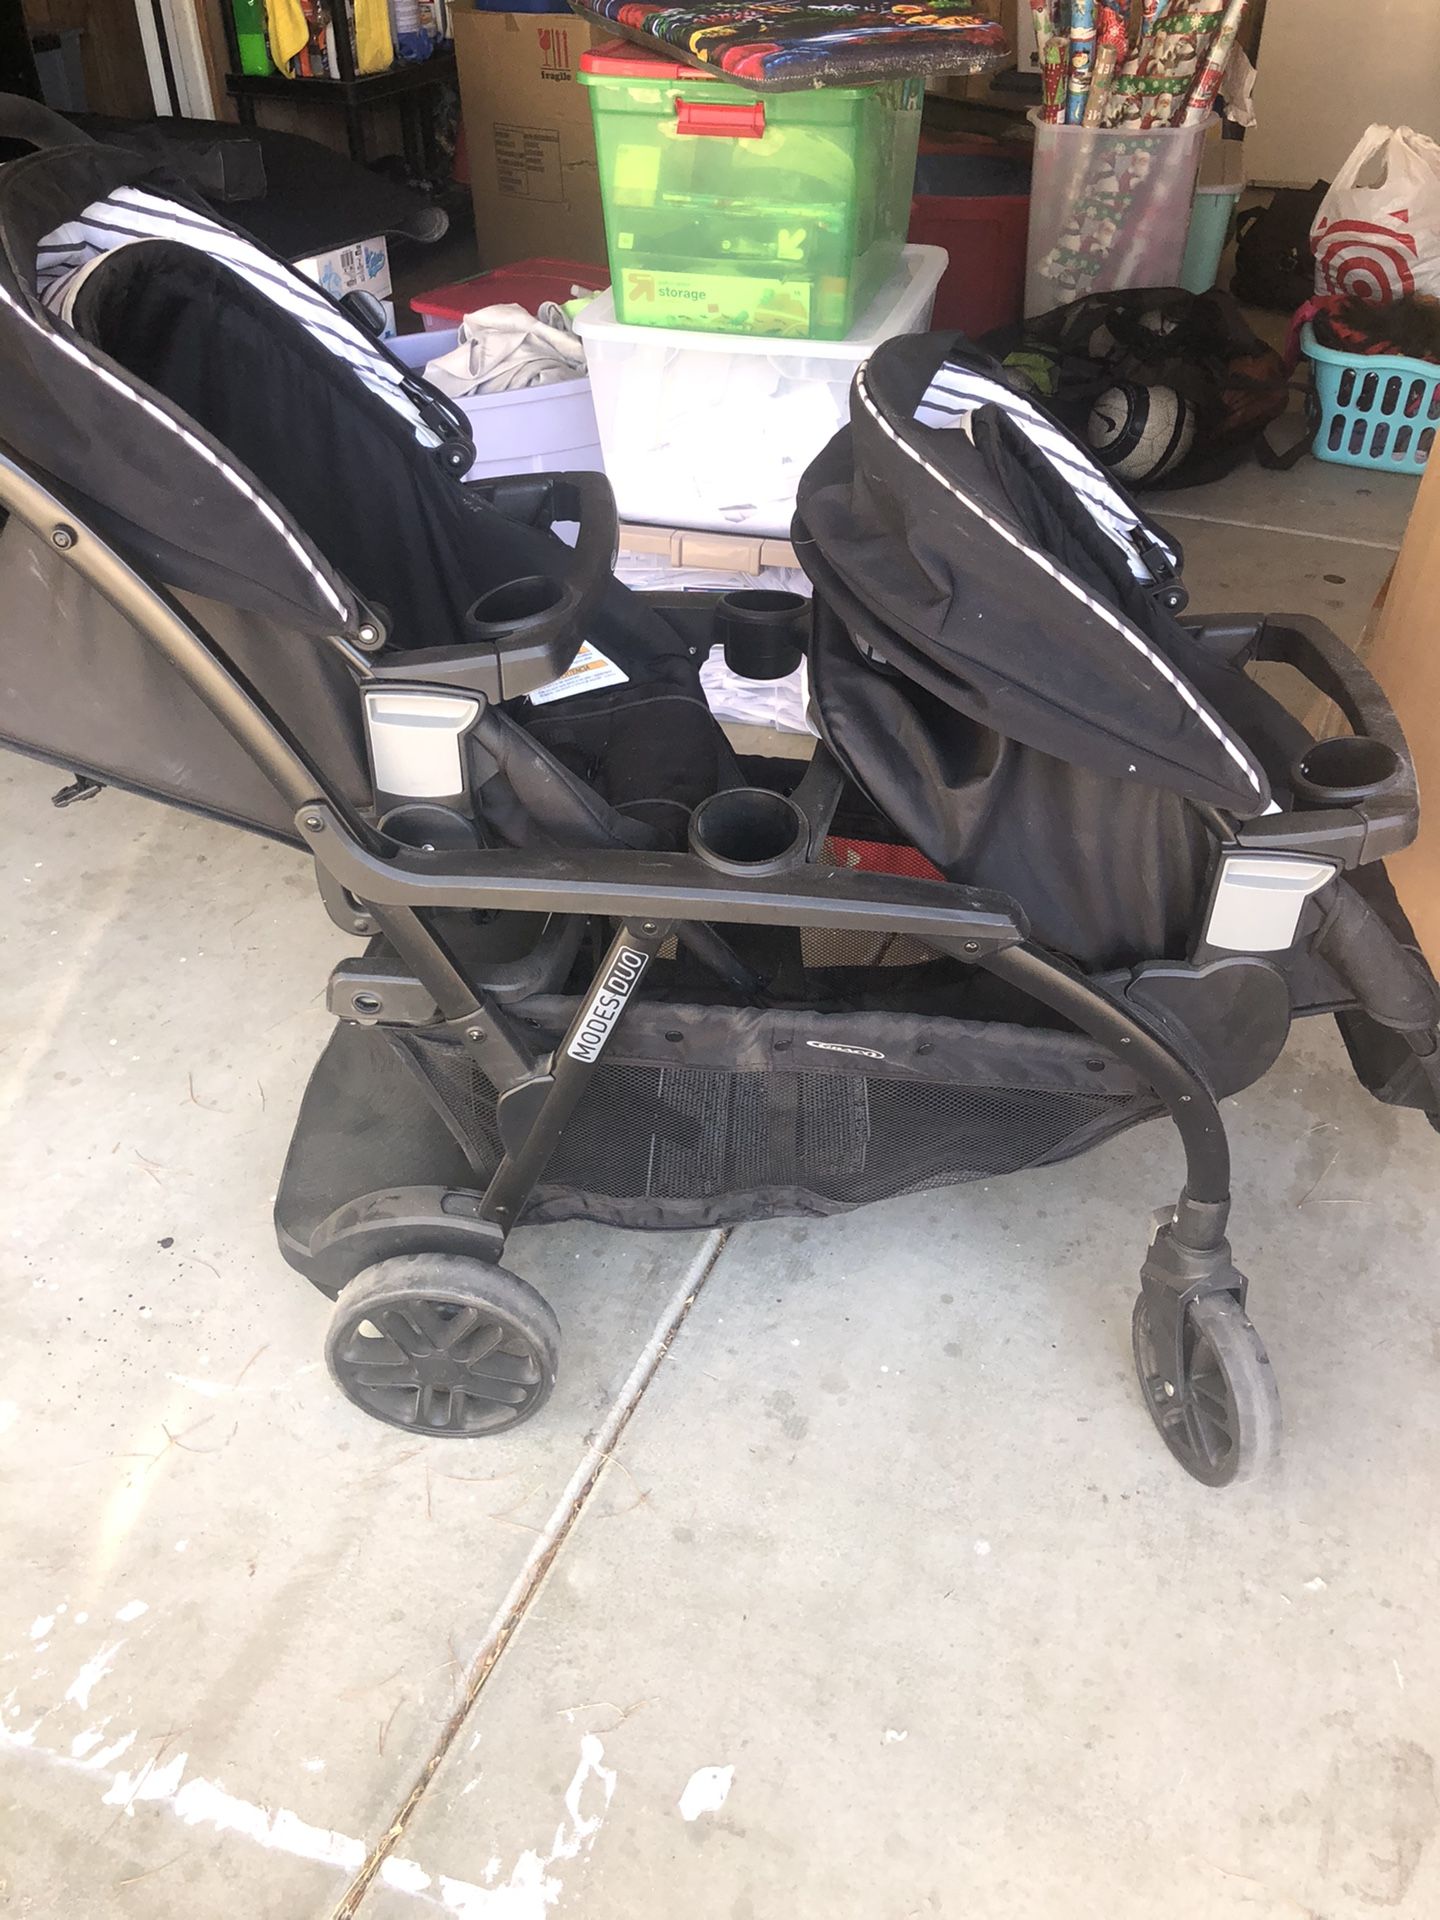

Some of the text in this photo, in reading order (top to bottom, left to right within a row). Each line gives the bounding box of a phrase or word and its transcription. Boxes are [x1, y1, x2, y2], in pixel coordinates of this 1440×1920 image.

[541, 71, 572, 82] fragile
[658, 286, 706, 301] storage
[572, 951, 642, 1060] MODES DUO
